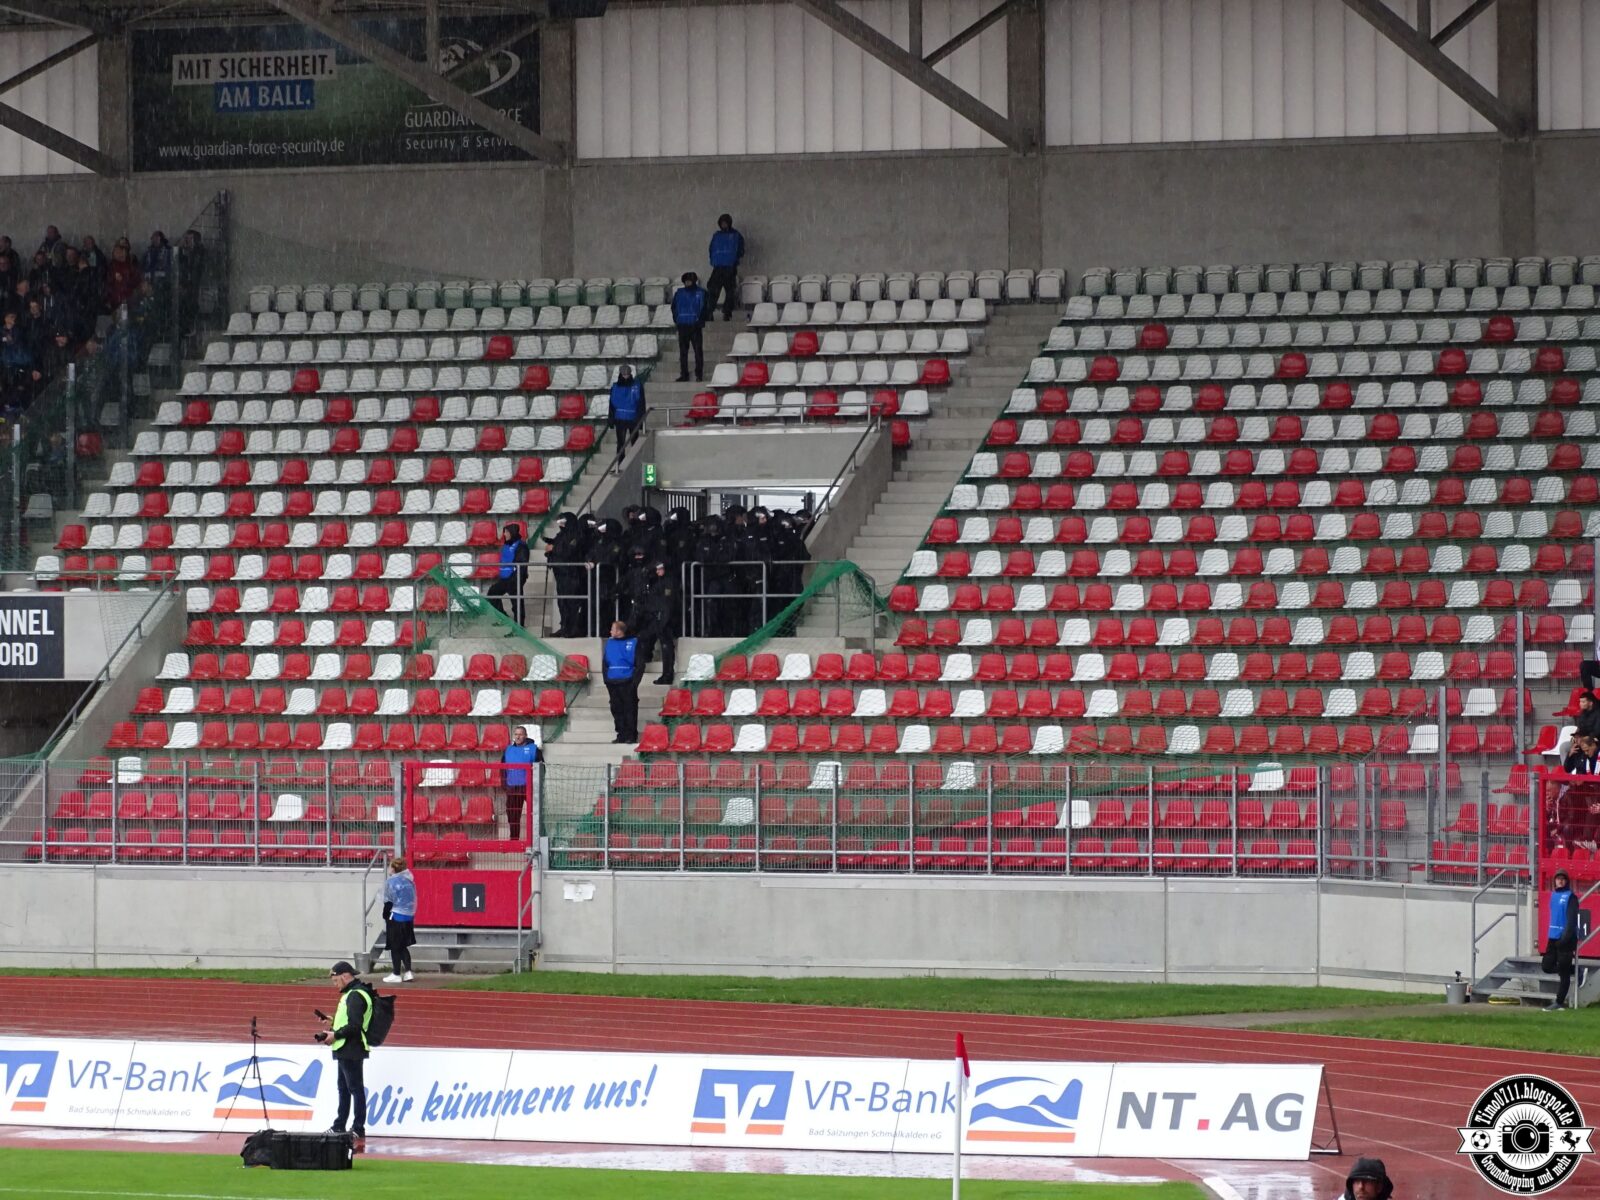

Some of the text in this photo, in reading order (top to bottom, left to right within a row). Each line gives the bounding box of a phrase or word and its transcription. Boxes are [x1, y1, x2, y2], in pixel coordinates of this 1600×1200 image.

[178, 54, 334, 80] MIT SICHERHEIT.
[219, 84, 312, 108] AM BALL.
[158, 137, 346, 160] www.guardian-force-security.de
[406, 137, 456, 151] Security
[68, 1059, 211, 1093] VR-Bank
[364, 1064, 658, 1126] Wir kümmern uns!
[804, 1080, 956, 1114] VR-Bank
[68, 1105, 84, 1114] Bad
[85, 1105, 125, 1116] Salzungen
[808, 1128, 825, 1136] Bad
[826, 1129, 869, 1139] Salzungen
[871, 1130, 929, 1139] Schmalkalden
